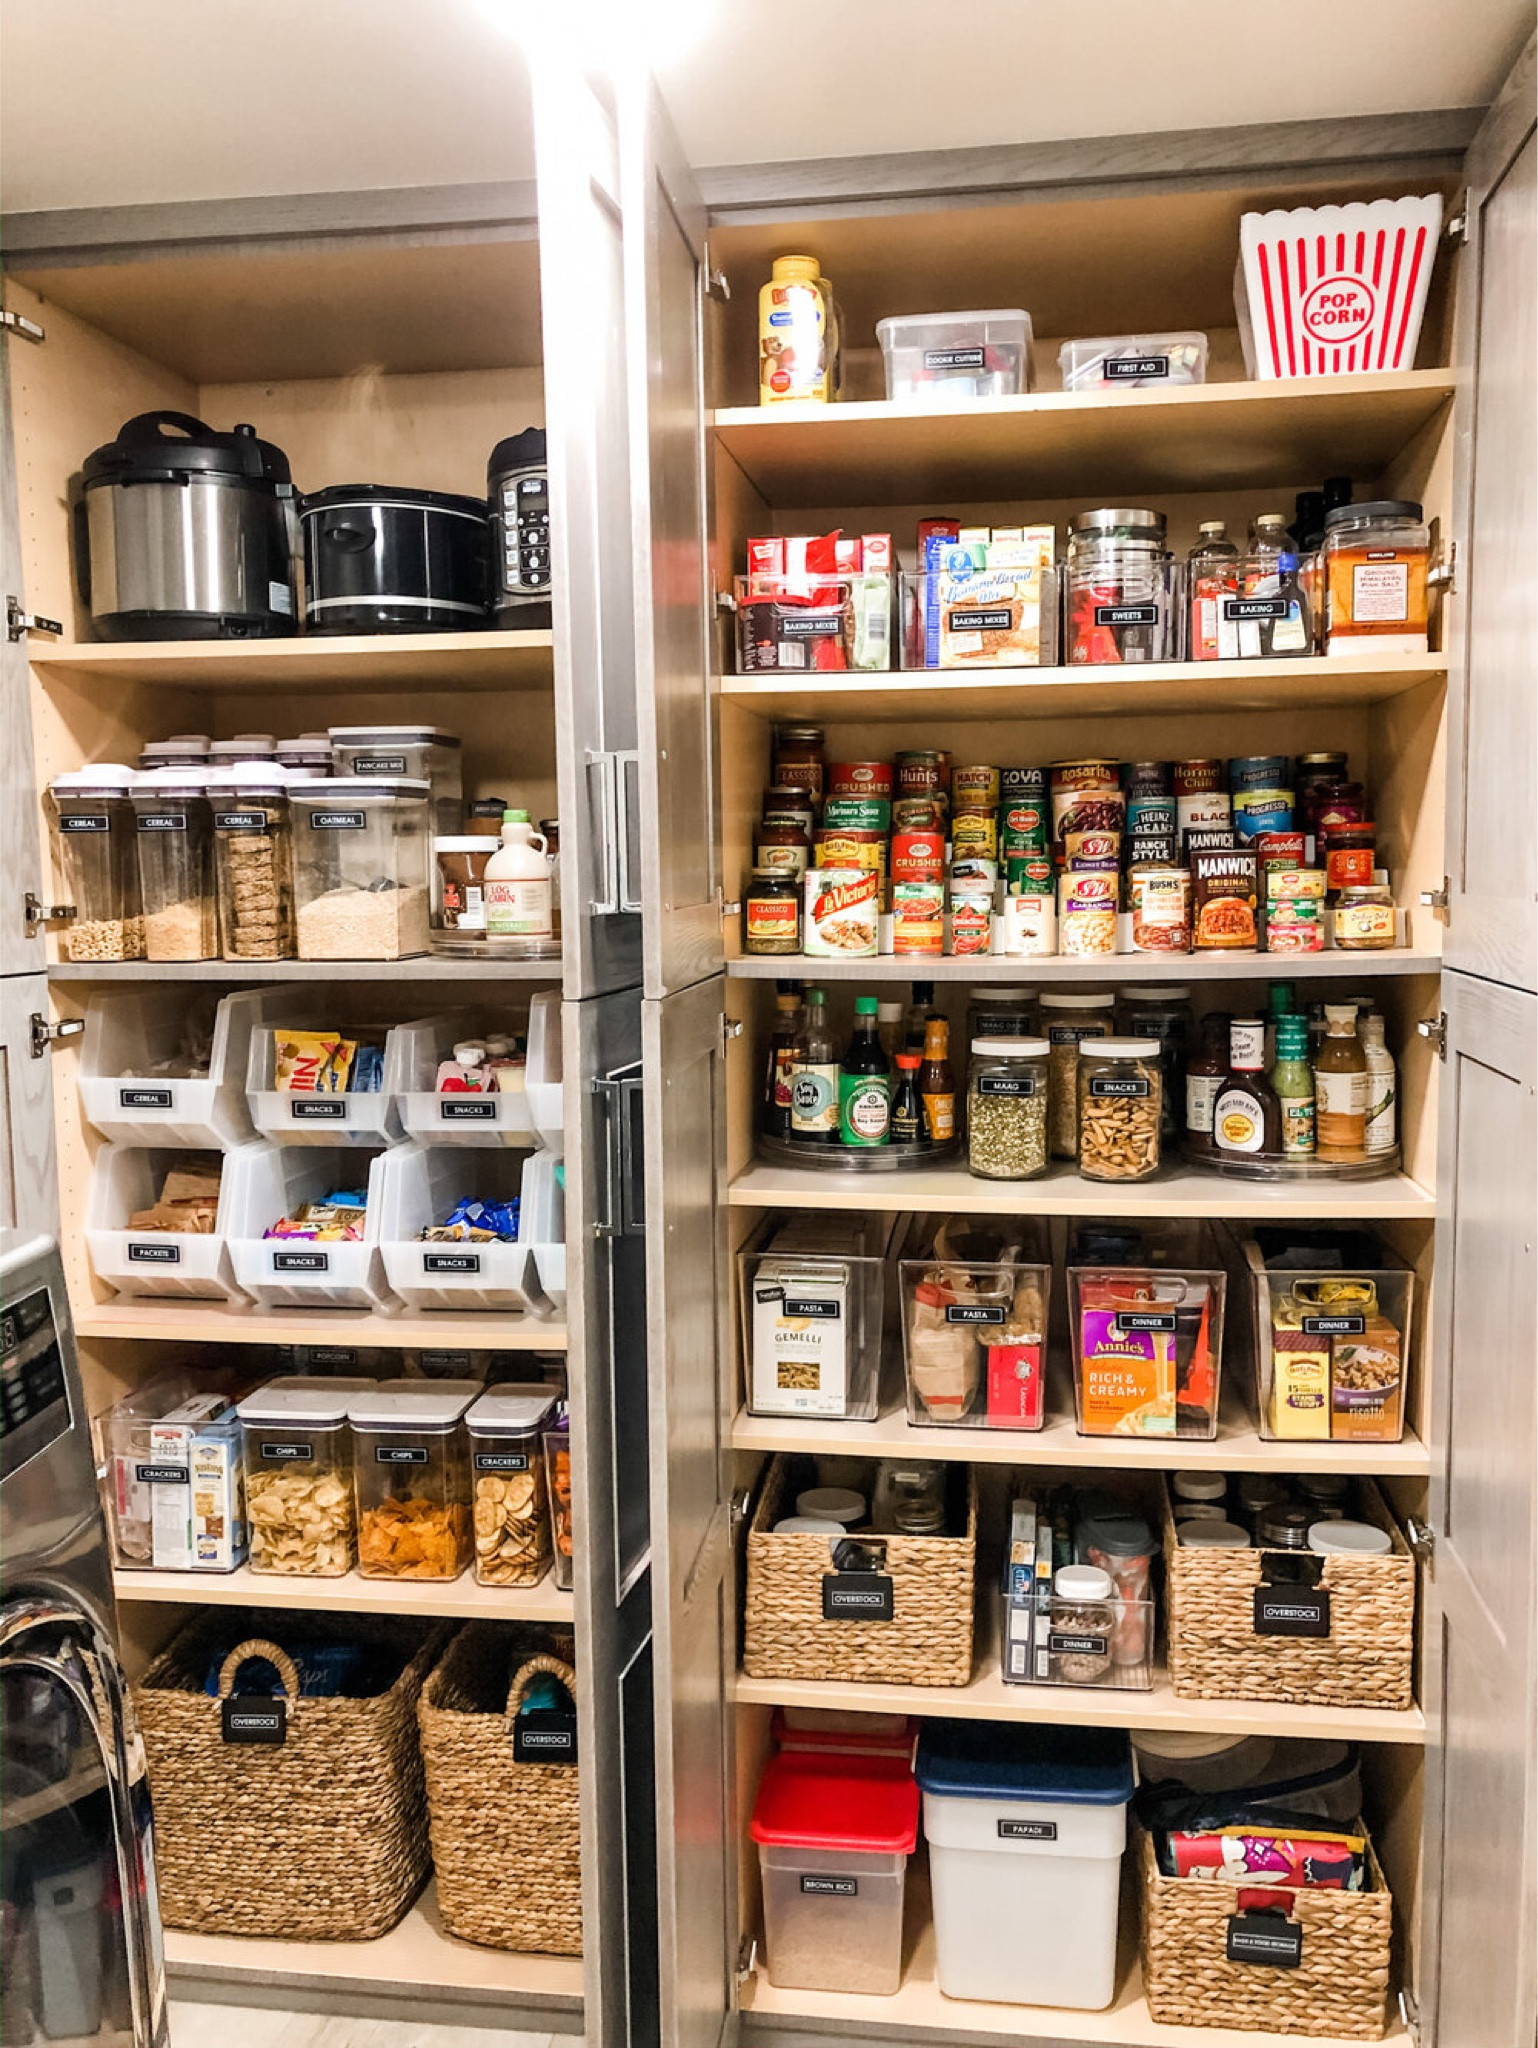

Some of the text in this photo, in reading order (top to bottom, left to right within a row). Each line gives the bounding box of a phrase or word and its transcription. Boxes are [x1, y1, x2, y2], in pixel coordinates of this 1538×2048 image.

[1319, 293, 1358, 309] POP
[1309, 308, 1365, 326] CORN
[1117, 363, 1156, 373] FIRST AID
[1240, 604, 1274, 614] BAKING
[952, 616, 1008, 626] BAKING MIXES
[1111, 611, 1142, 621] SWEETS
[785, 621, 839, 630] BAKING MIXES
[900, 767, 939, 784] Hunt's
[1002, 769, 1042, 785] GOYA
[1174, 767, 1220, 778] Hormel
[834, 783, 890, 793] CRUSHED
[1246, 801, 1286, 816] PROGRESSO
[68, 820, 96, 828] CEREAL
[146, 819, 174, 827] CEREAL
[224, 817, 252, 825] CEREAL
[320, 816, 356, 825] OATMEAL
[1134, 840, 1166, 850] RANCH
[1188, 832, 1235, 850] MANWICH
[1132, 850, 1170, 861] STYLE
[1207, 879, 1249, 887] ORIGINAL
[491, 885, 510, 895] LOG
[756, 905, 788, 914] CLASSICO
[993, 1081, 1020, 1092] MAAG
[1103, 1083, 1137, 1093] SNACKS
[133, 1094, 159, 1103] CEREAL
[304, 1105, 334, 1114] SNACKS
[454, 1105, 484, 1115] SNACKS
[140, 1249, 169, 1258] PACKETS
[286, 1257, 316, 1266] SNACKS
[437, 1259, 467, 1268] SNACKS
[798, 1304, 824, 1313] PASTA
[963, 1311, 988, 1319] PASTA
[1131, 1318, 1163, 1327] DINNER
[1318, 1321, 1350, 1330] DINNER
[774, 1331, 823, 1345] GEMELLI
[1094, 1340, 1145, 1355] Annie's
[1089, 1372, 1135, 1385] RICH &
[1089, 1385, 1147, 1398] CREAMY
[276, 1447, 297, 1456] CHIPS
[391, 1451, 413, 1460] CHIPS
[482, 1457, 521, 1466] CRACKERS
[144, 1470, 182, 1478] CRACKERS
[834, 1594, 881, 1604] OVERSTOCK
[1266, 1607, 1316, 1618] OVERSTOCK
[1063, 1640, 1093, 1649] DINNER
[233, 1717, 276, 1728] OVERSTOCK
[524, 1734, 570, 1745] OVERSTOCK
[806, 1880, 853, 1891] BROWN RICE
